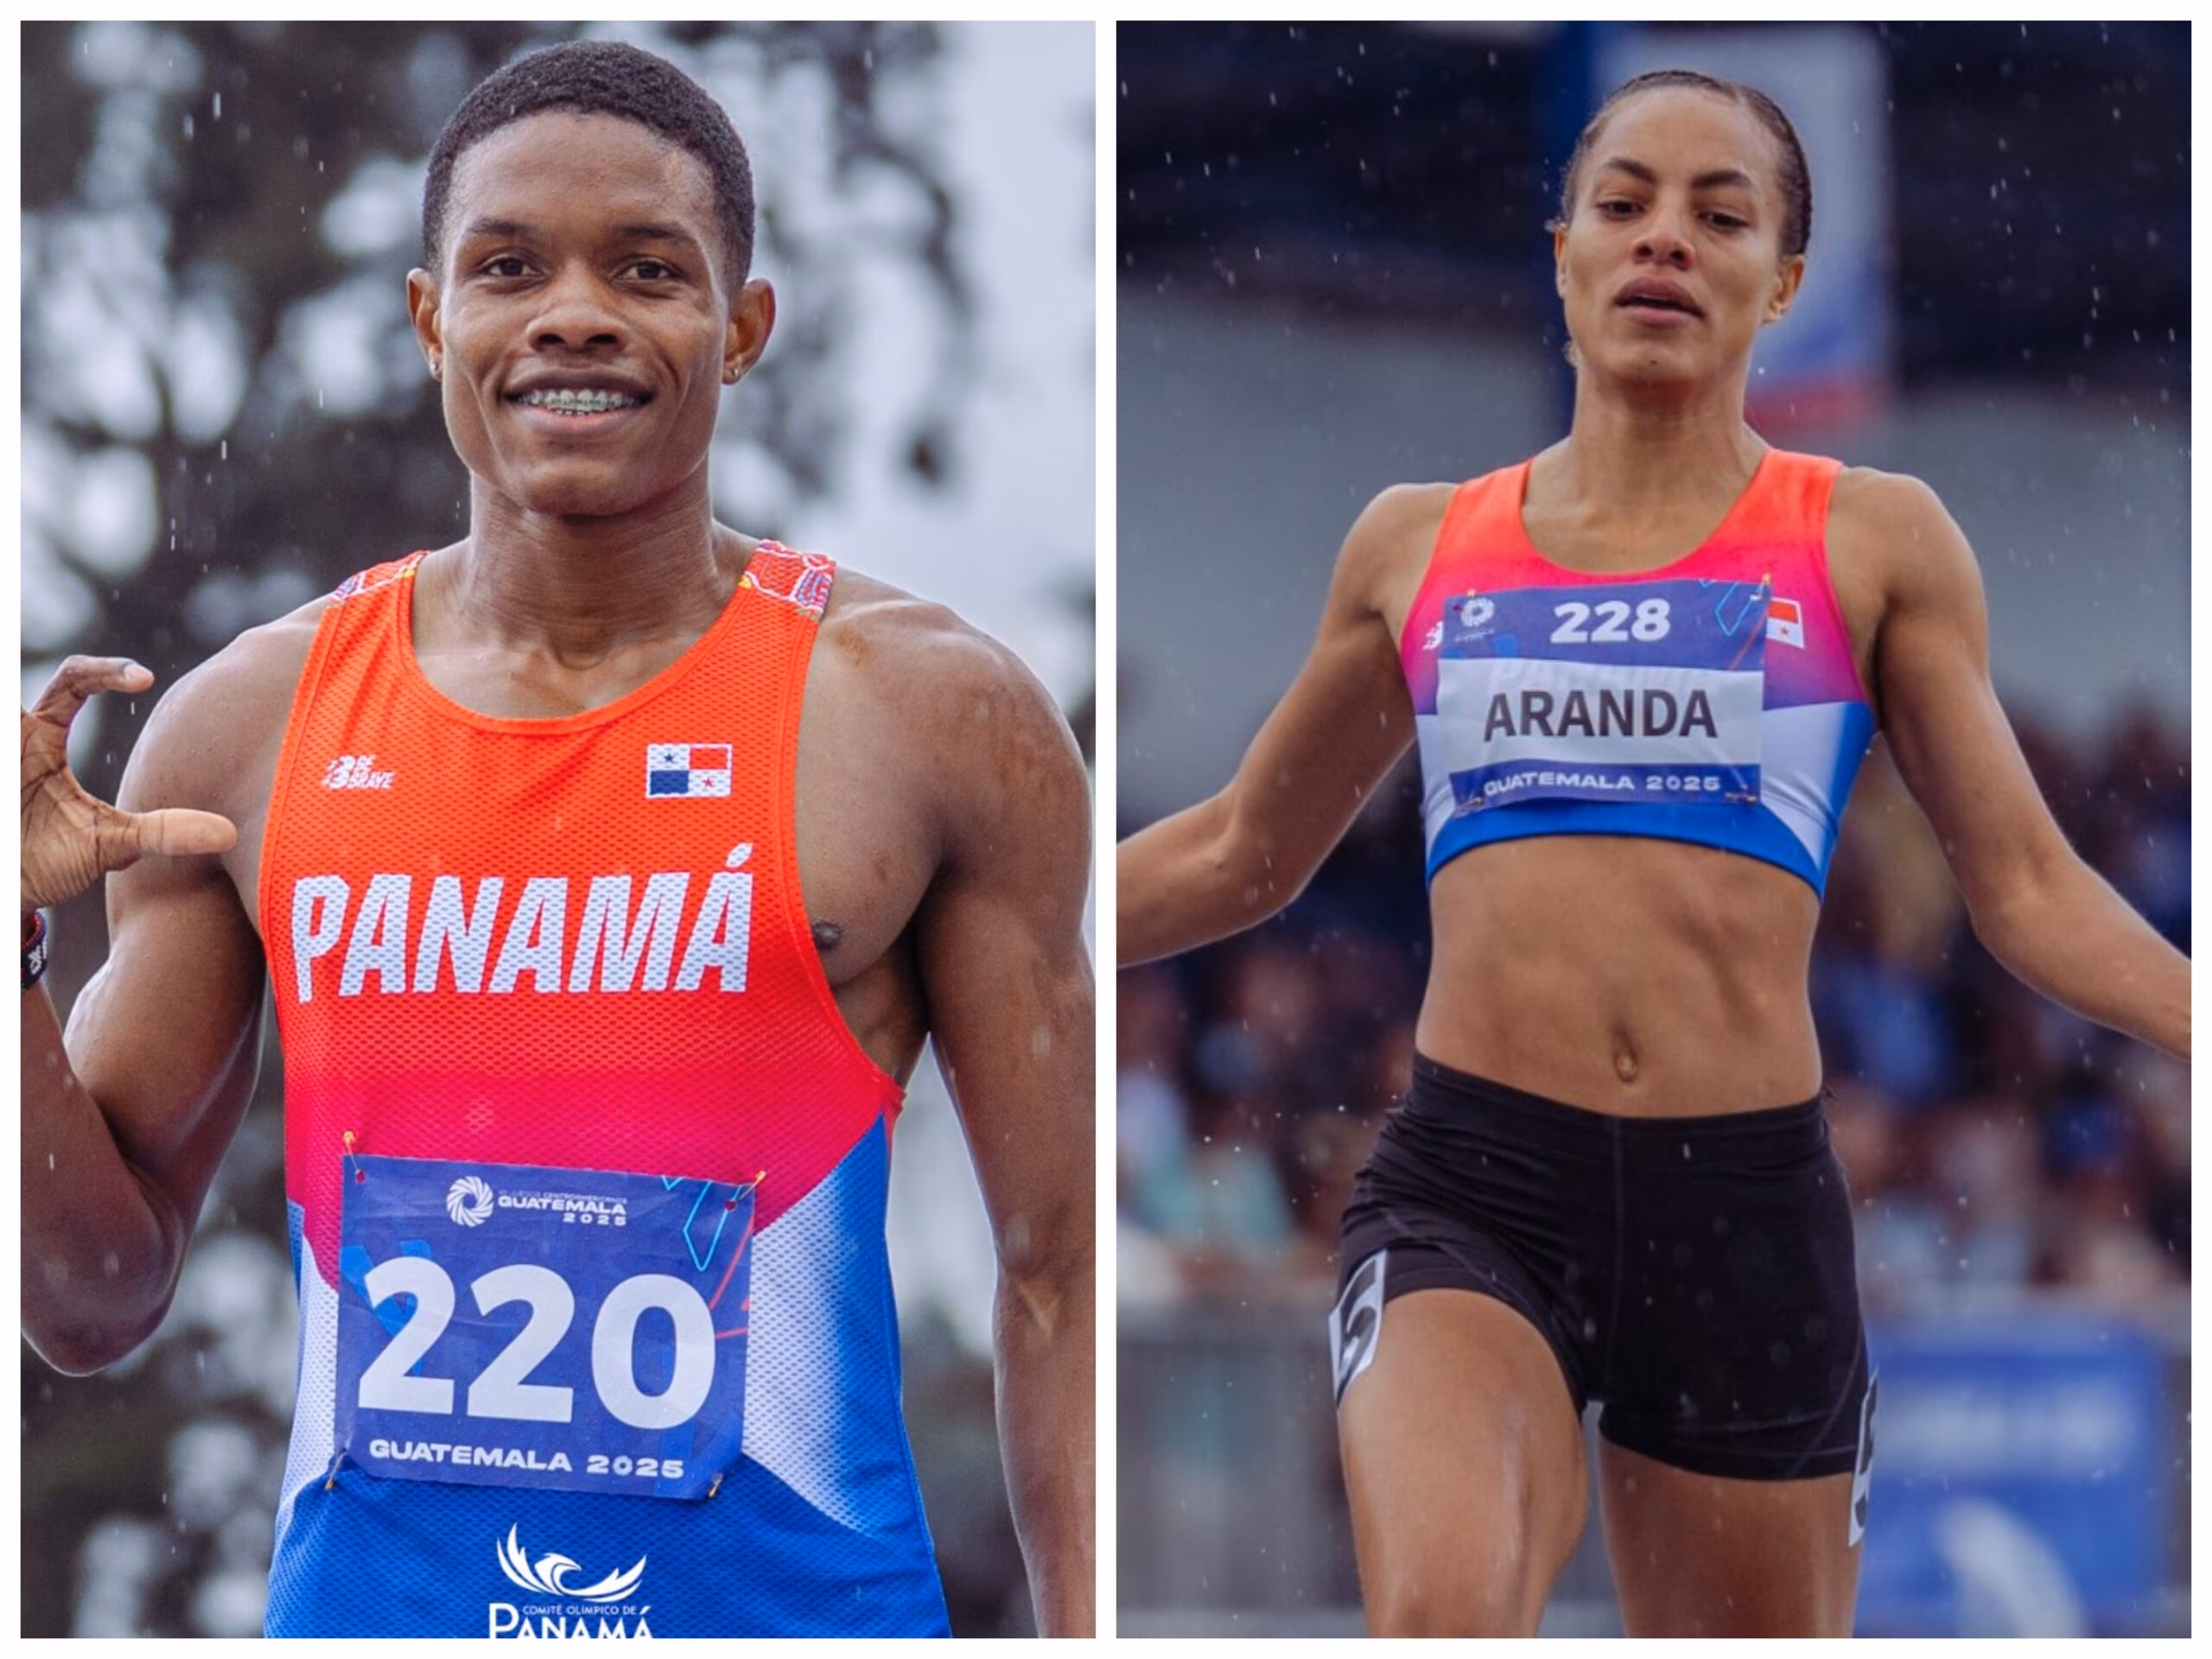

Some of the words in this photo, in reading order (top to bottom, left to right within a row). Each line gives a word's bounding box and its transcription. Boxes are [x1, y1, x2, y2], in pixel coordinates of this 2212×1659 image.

[1549, 597, 1671, 644] 228
[1484, 690, 1718, 742] ARANDA
[1484, 772, 1635, 796] GUATEMALA
[1645, 775, 1721, 791] 2025
[291, 842, 753, 1002] PANAMÁ
[498, 1196, 627, 1215] GUATEMALA
[563, 1212, 627, 1226] 2025
[358, 1255, 716, 1430] 220
[369, 1439, 573, 1471] GUATEMALA
[586, 1454, 684, 1479] 2025
[488, 1603, 654, 1639] PANAMÁ
[522, 1604, 563, 1615] COMITÉ
[622, 1605, 637, 1615] DE
